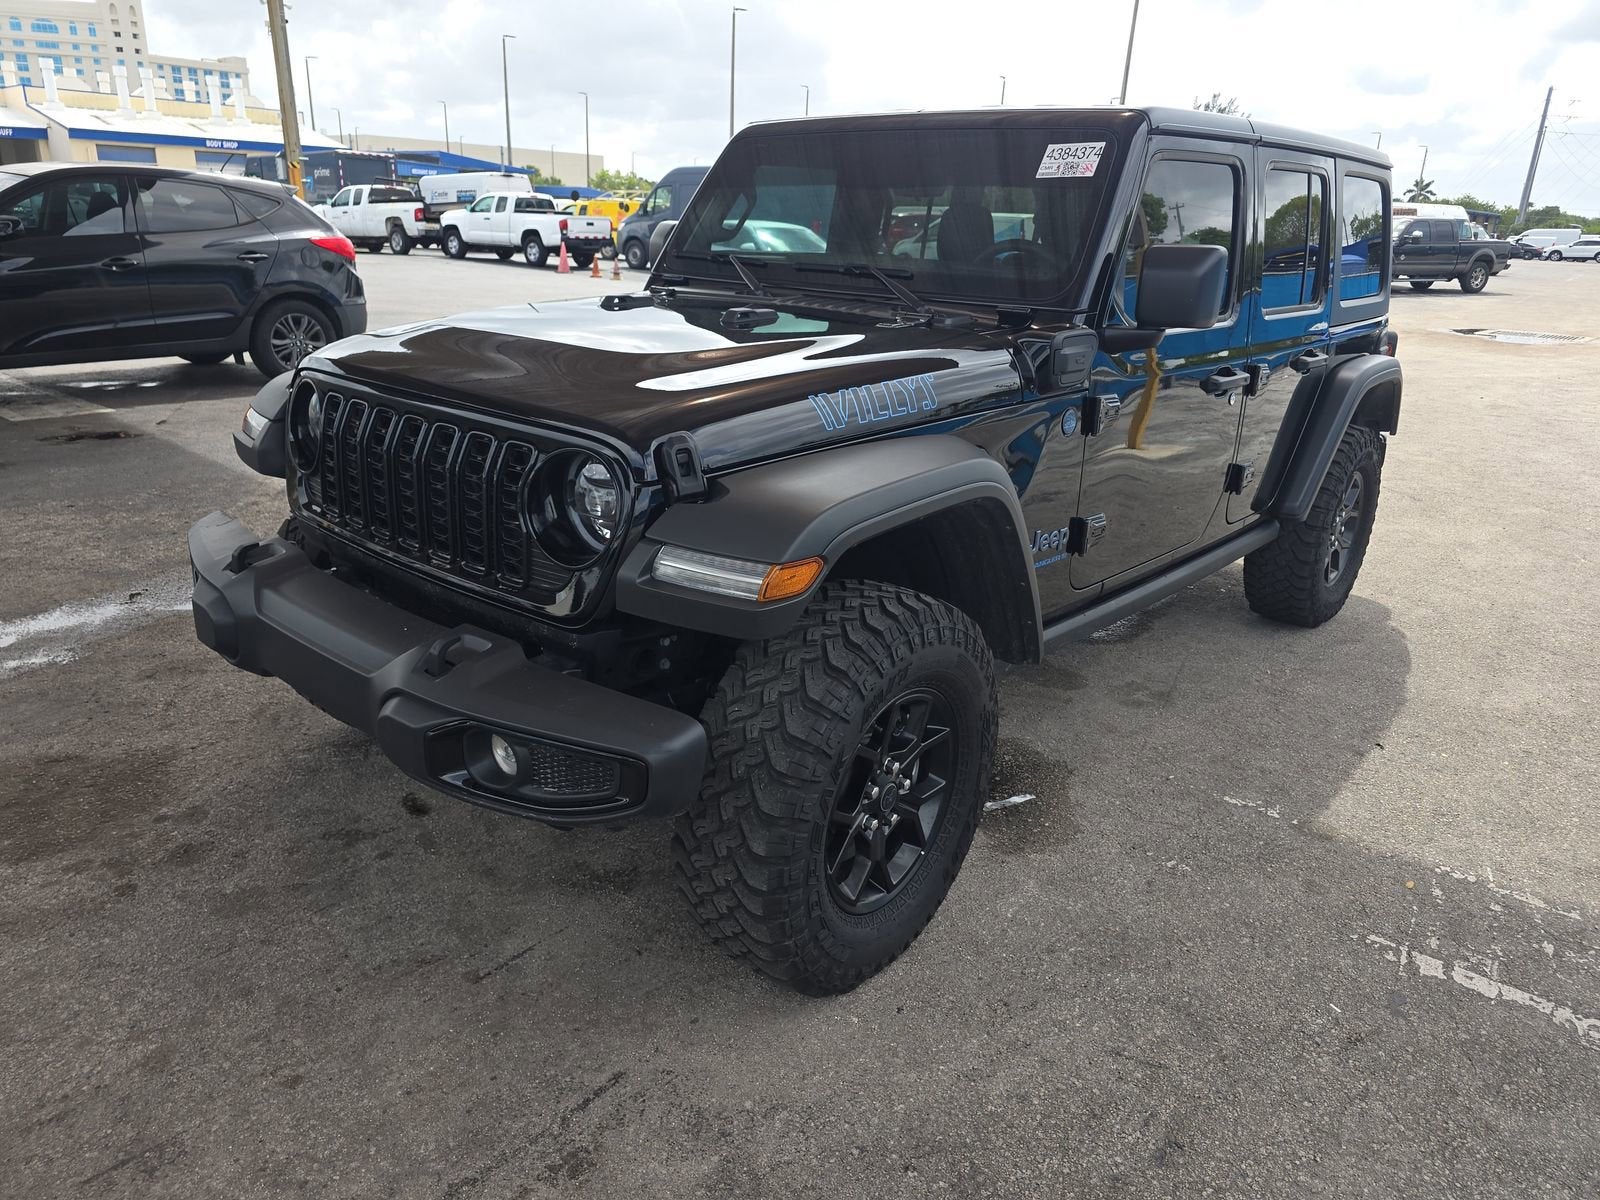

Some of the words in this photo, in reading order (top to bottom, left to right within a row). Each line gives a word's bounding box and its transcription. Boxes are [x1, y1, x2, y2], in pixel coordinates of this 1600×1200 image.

[0, 127, 13, 136] UFF
[206, 139, 222, 148] BODY
[222, 140, 238, 149] SHOP
[1046, 146, 1103, 160] 4384374
[314, 167, 330, 178] prime
[808, 374, 938, 431] WILLYS
[1029, 527, 1070, 554] Jeep
